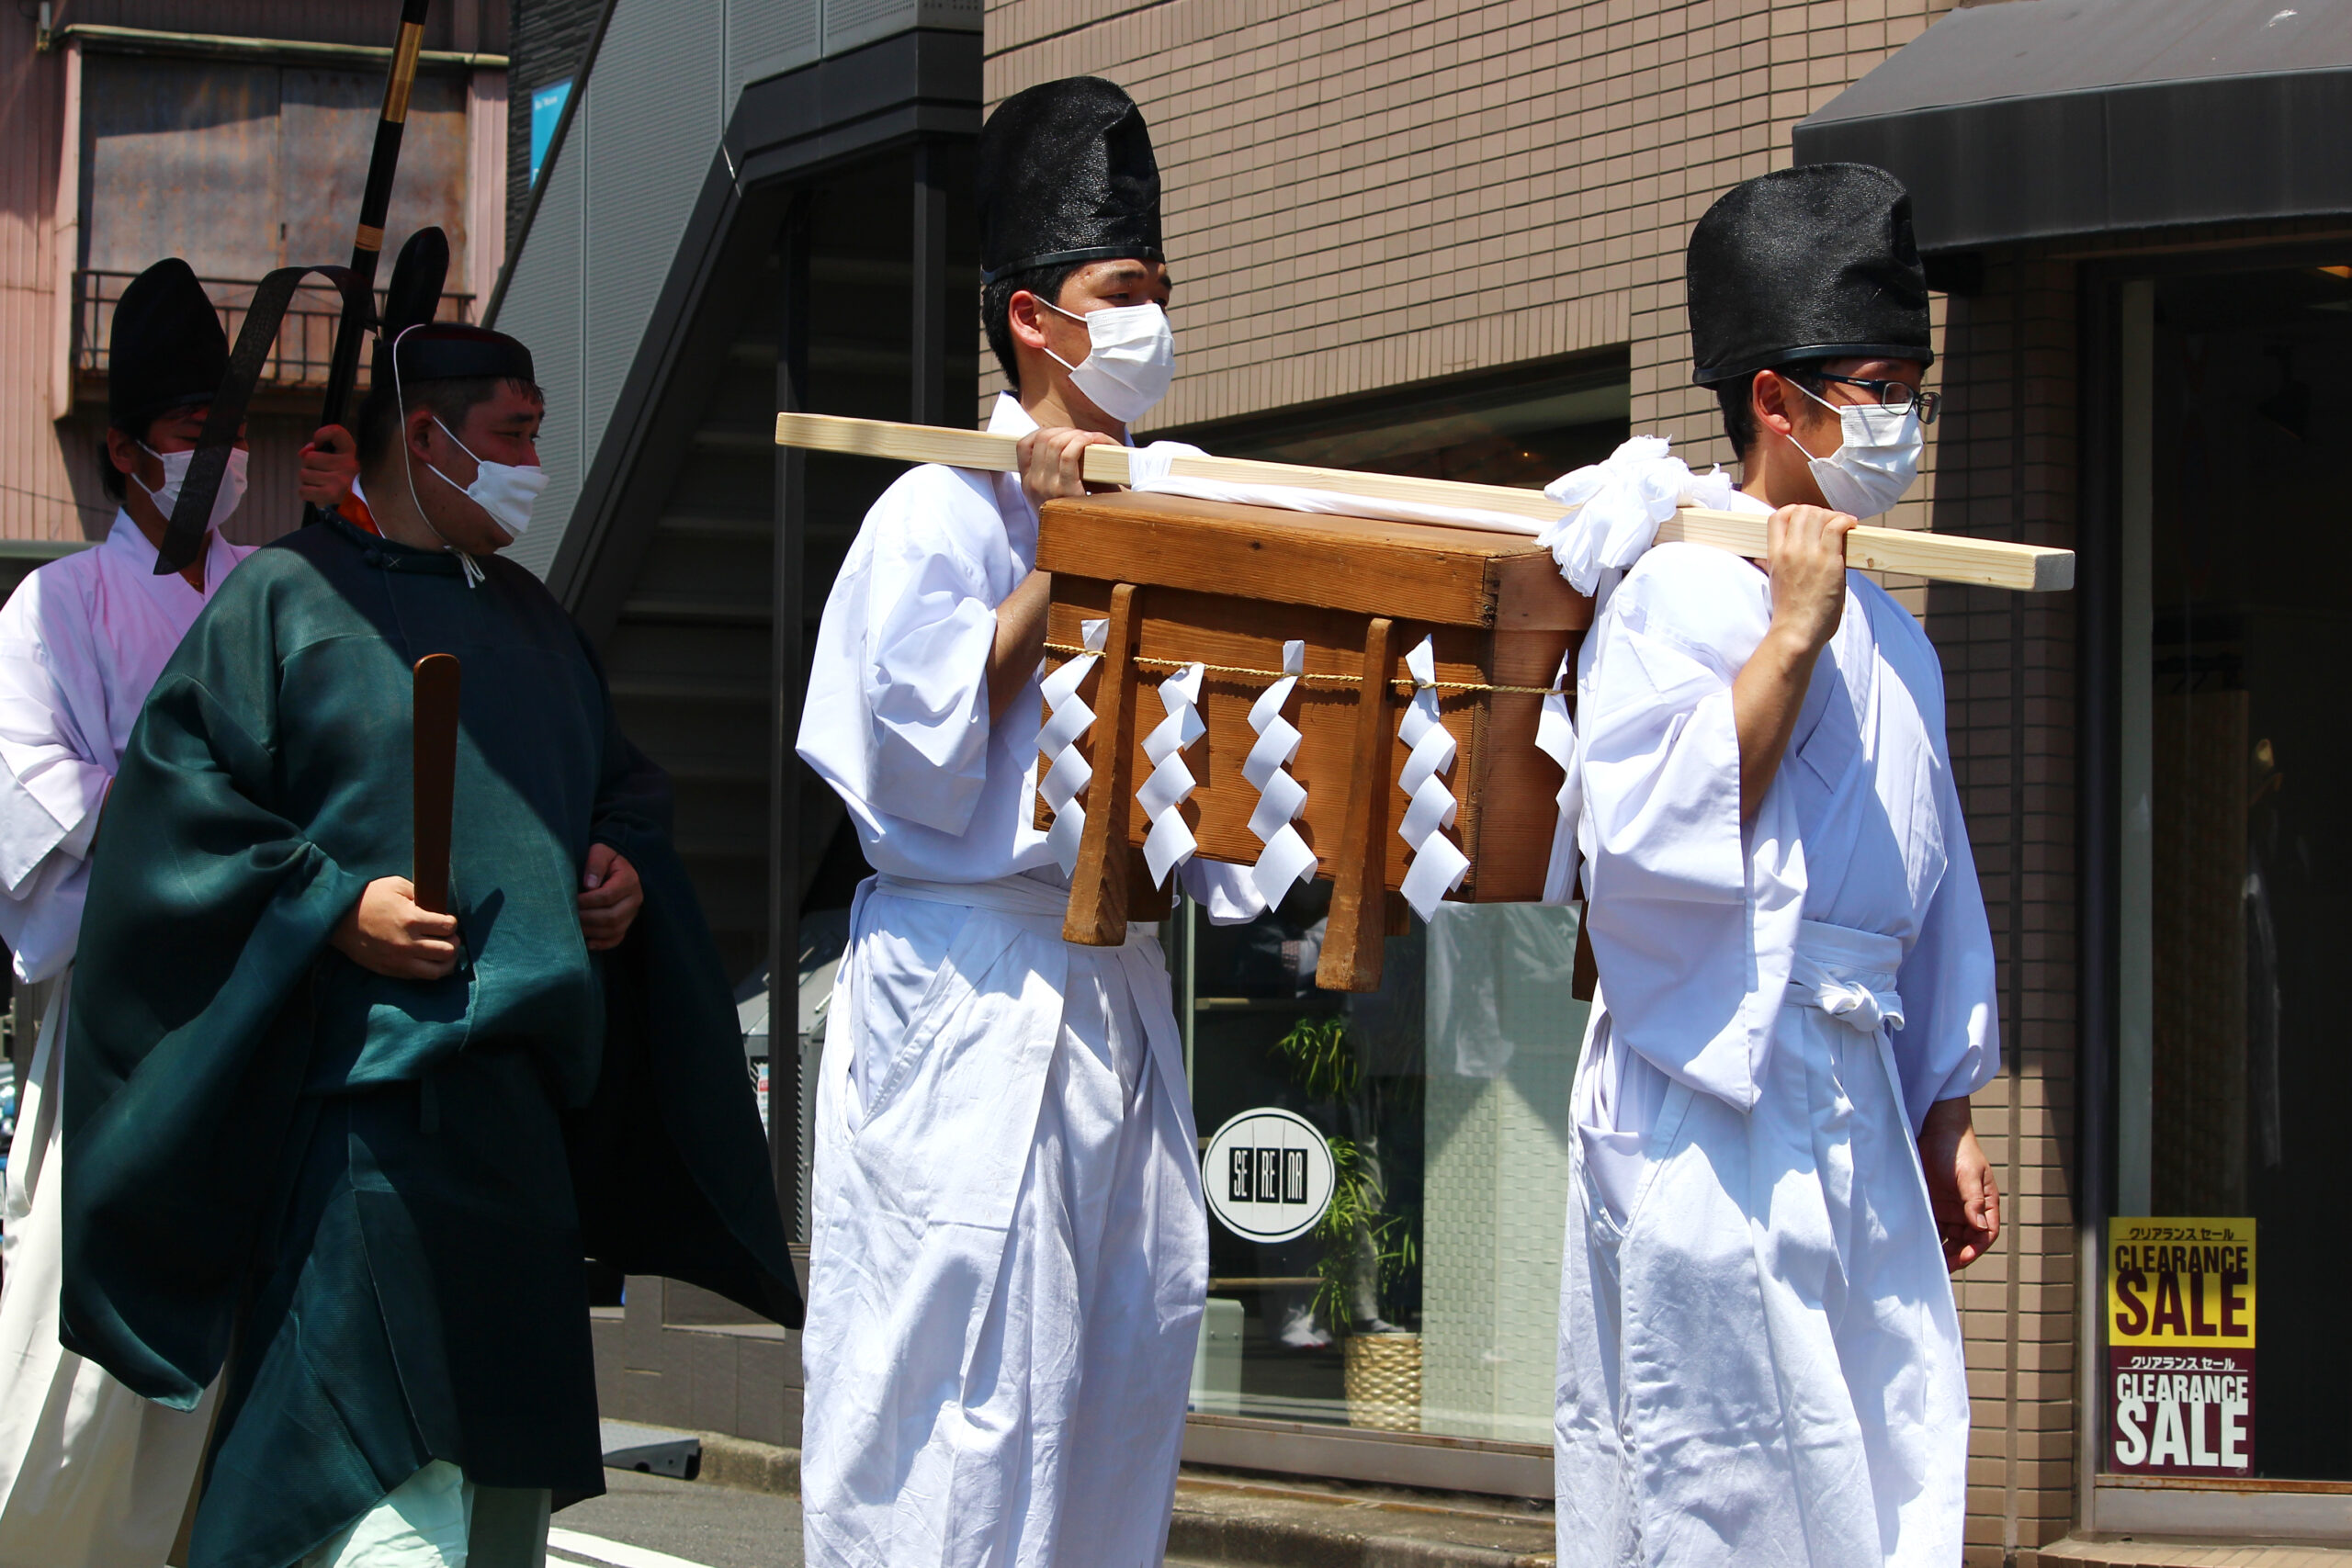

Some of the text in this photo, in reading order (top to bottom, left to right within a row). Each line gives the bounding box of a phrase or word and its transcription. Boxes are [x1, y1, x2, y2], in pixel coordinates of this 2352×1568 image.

[2129, 1227, 2234, 1241] クリアランス セール
[2115, 1245, 2248, 1273] CLEARANCE
[2115, 1268, 2249, 1337] SALE
[2131, 1356, 2235, 1371] クリアランス セール
[2117, 1373, 2249, 1404] CLEARANCE
[2115, 1398, 2249, 1468] SALE
